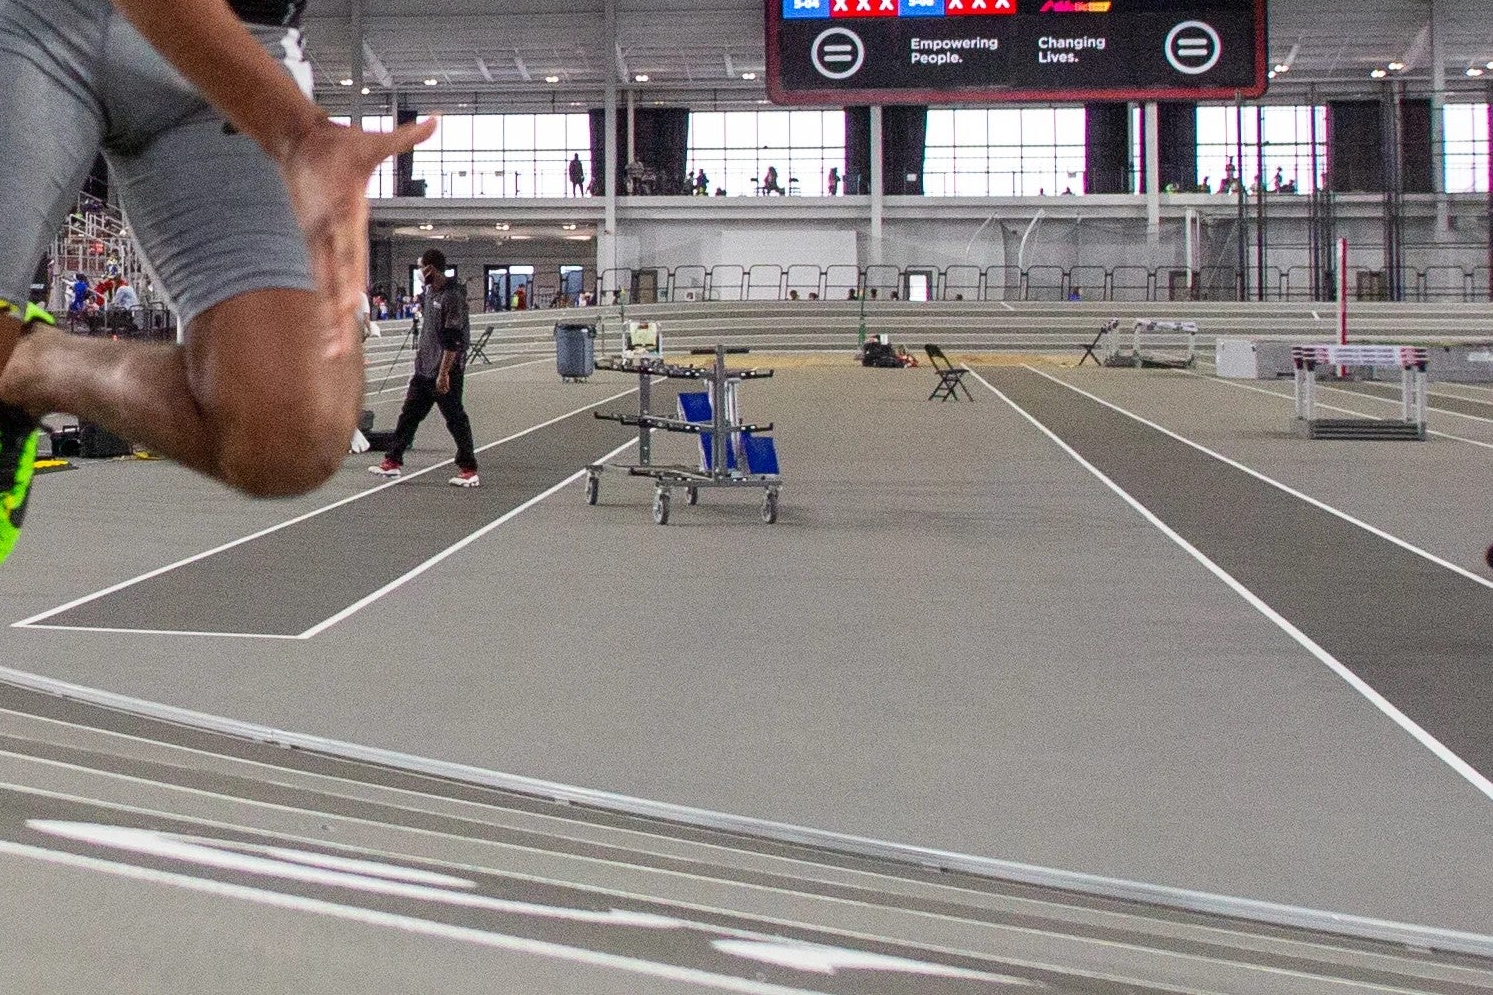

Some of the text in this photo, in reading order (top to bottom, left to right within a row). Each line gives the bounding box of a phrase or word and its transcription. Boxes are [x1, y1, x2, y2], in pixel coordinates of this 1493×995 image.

[910, 36, 998, 51] Empowering
[1038, 35, 1106, 50] Changing
[911, 52, 963, 65] People.
[1038, 51, 1079, 63] Lives.
